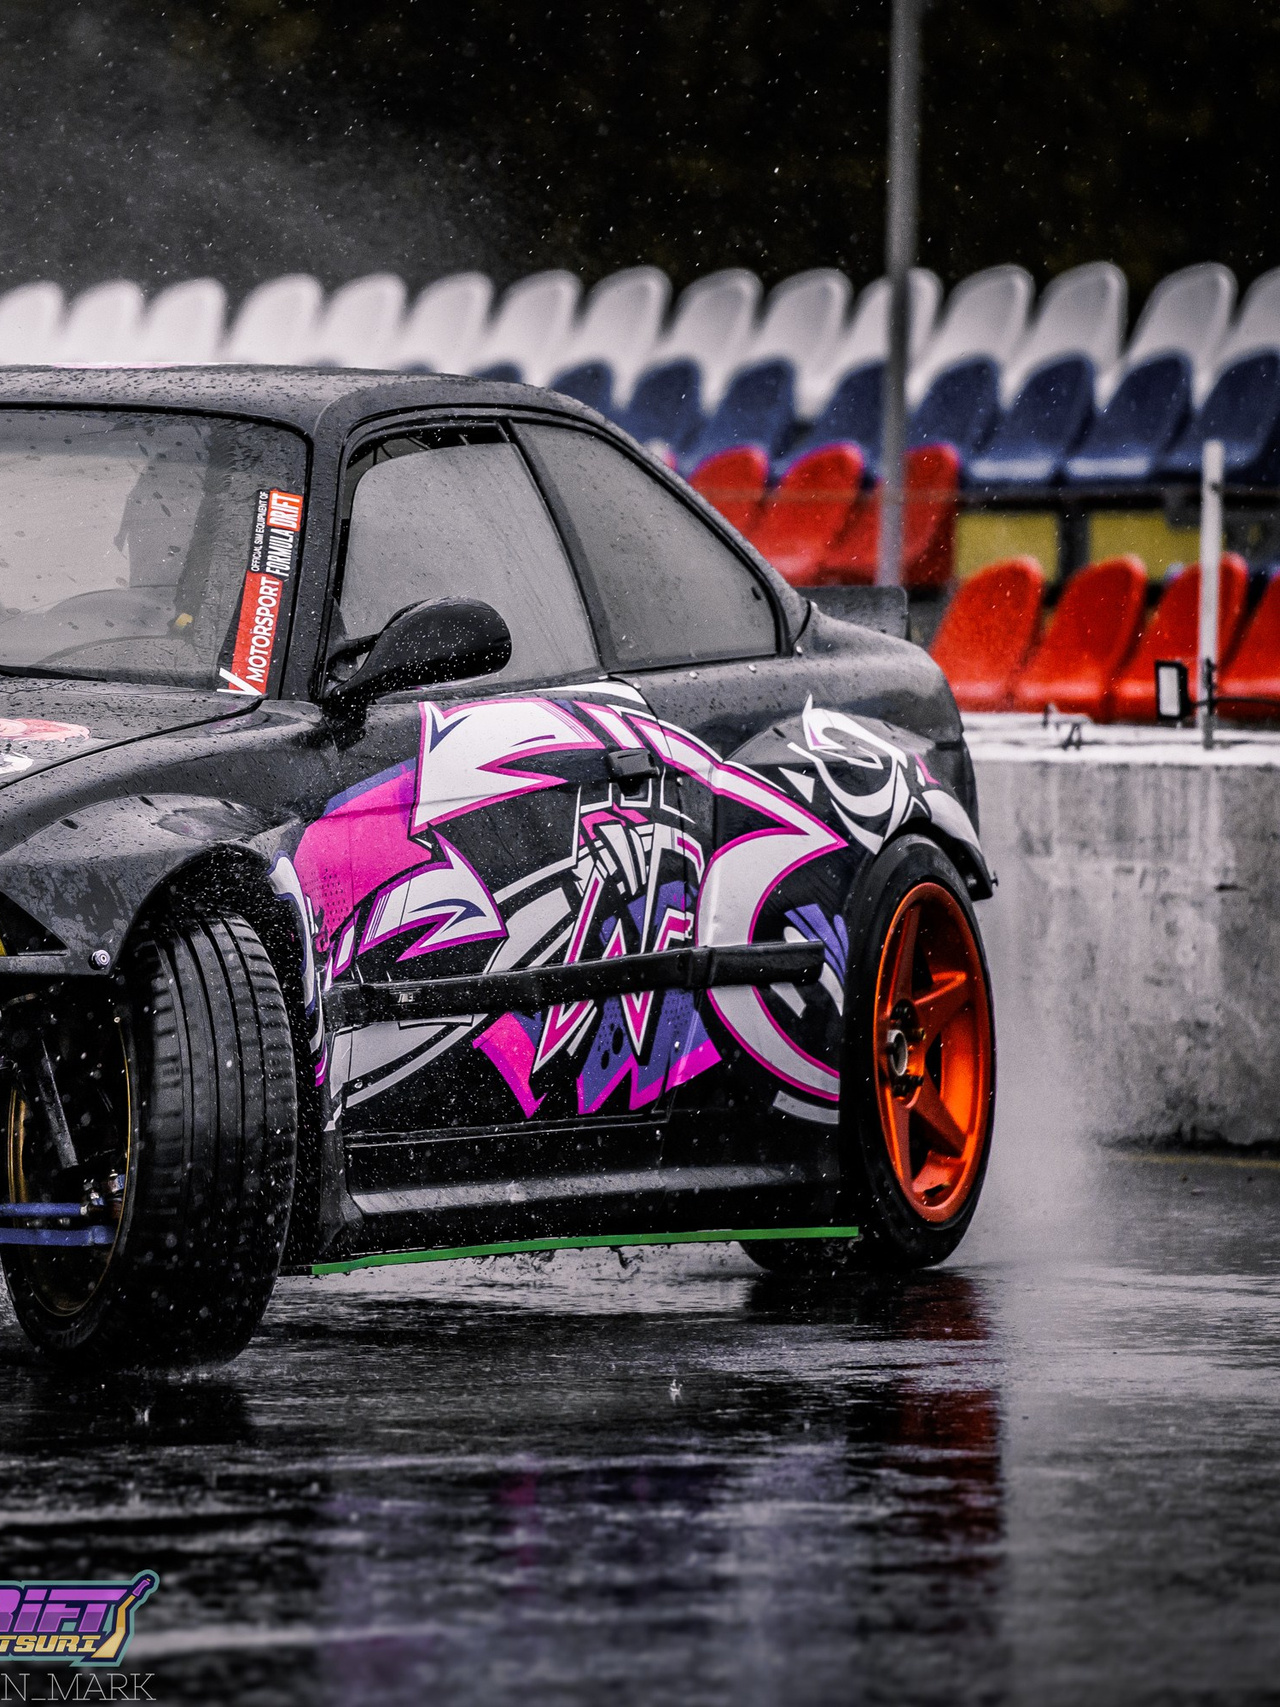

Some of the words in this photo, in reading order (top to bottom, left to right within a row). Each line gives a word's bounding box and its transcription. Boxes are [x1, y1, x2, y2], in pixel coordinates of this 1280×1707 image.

[259, 491, 269, 500] OF
[269, 492, 301, 529] DRIFT
[255, 499, 268, 533] EQUIPMENT
[253, 532, 265, 545] SIM
[265, 528, 295, 577] FORMULA
[250, 545, 263, 572] OFFICIAL
[246, 576, 280, 683] MOTORSPORT
